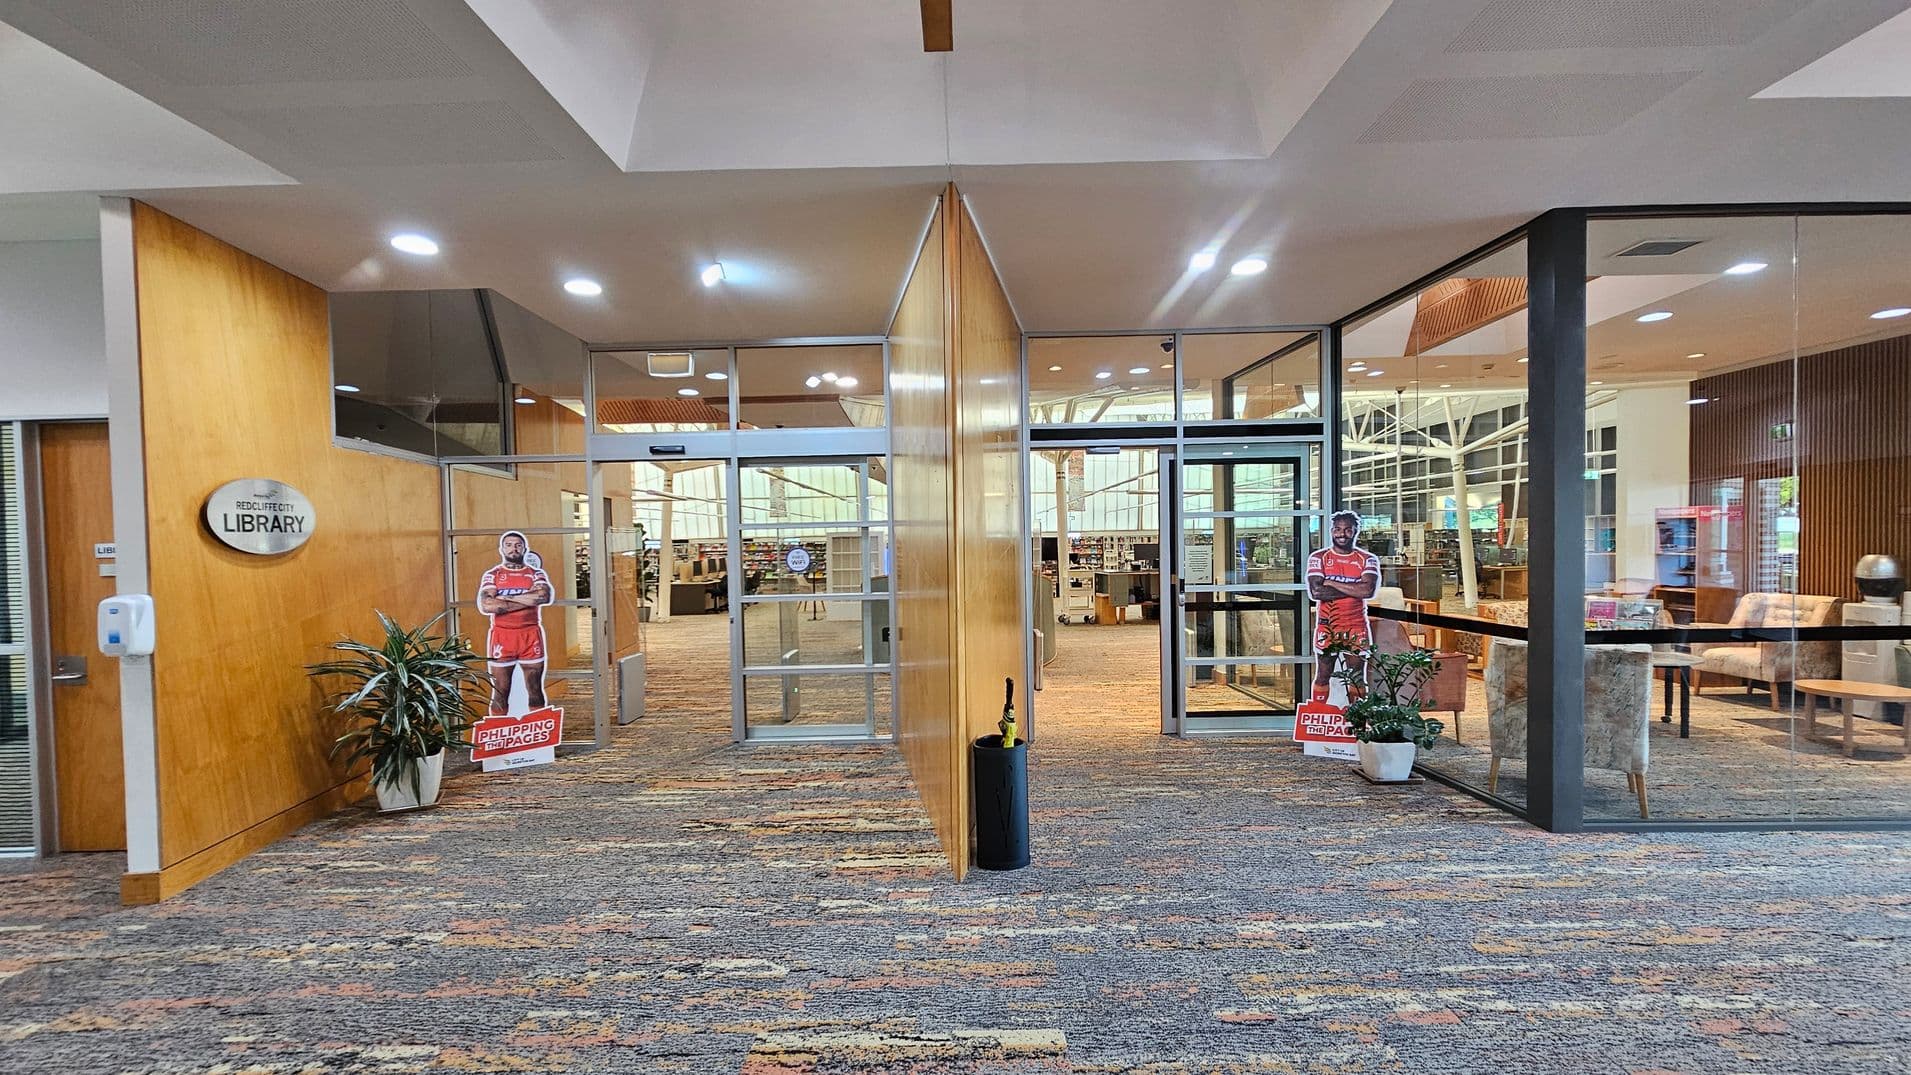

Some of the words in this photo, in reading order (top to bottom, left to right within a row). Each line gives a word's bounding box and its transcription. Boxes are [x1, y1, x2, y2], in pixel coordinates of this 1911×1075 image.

[236, 501, 278, 511] REDCLIFFE
[278, 503, 294, 512] CITY
[223, 512, 305, 533] LIBRARY
[480, 720, 554, 742] PHLIPPING
[1308, 726, 1324, 734] THE
[486, 742, 503, 750] THE
[505, 731, 548, 748] PAGES
